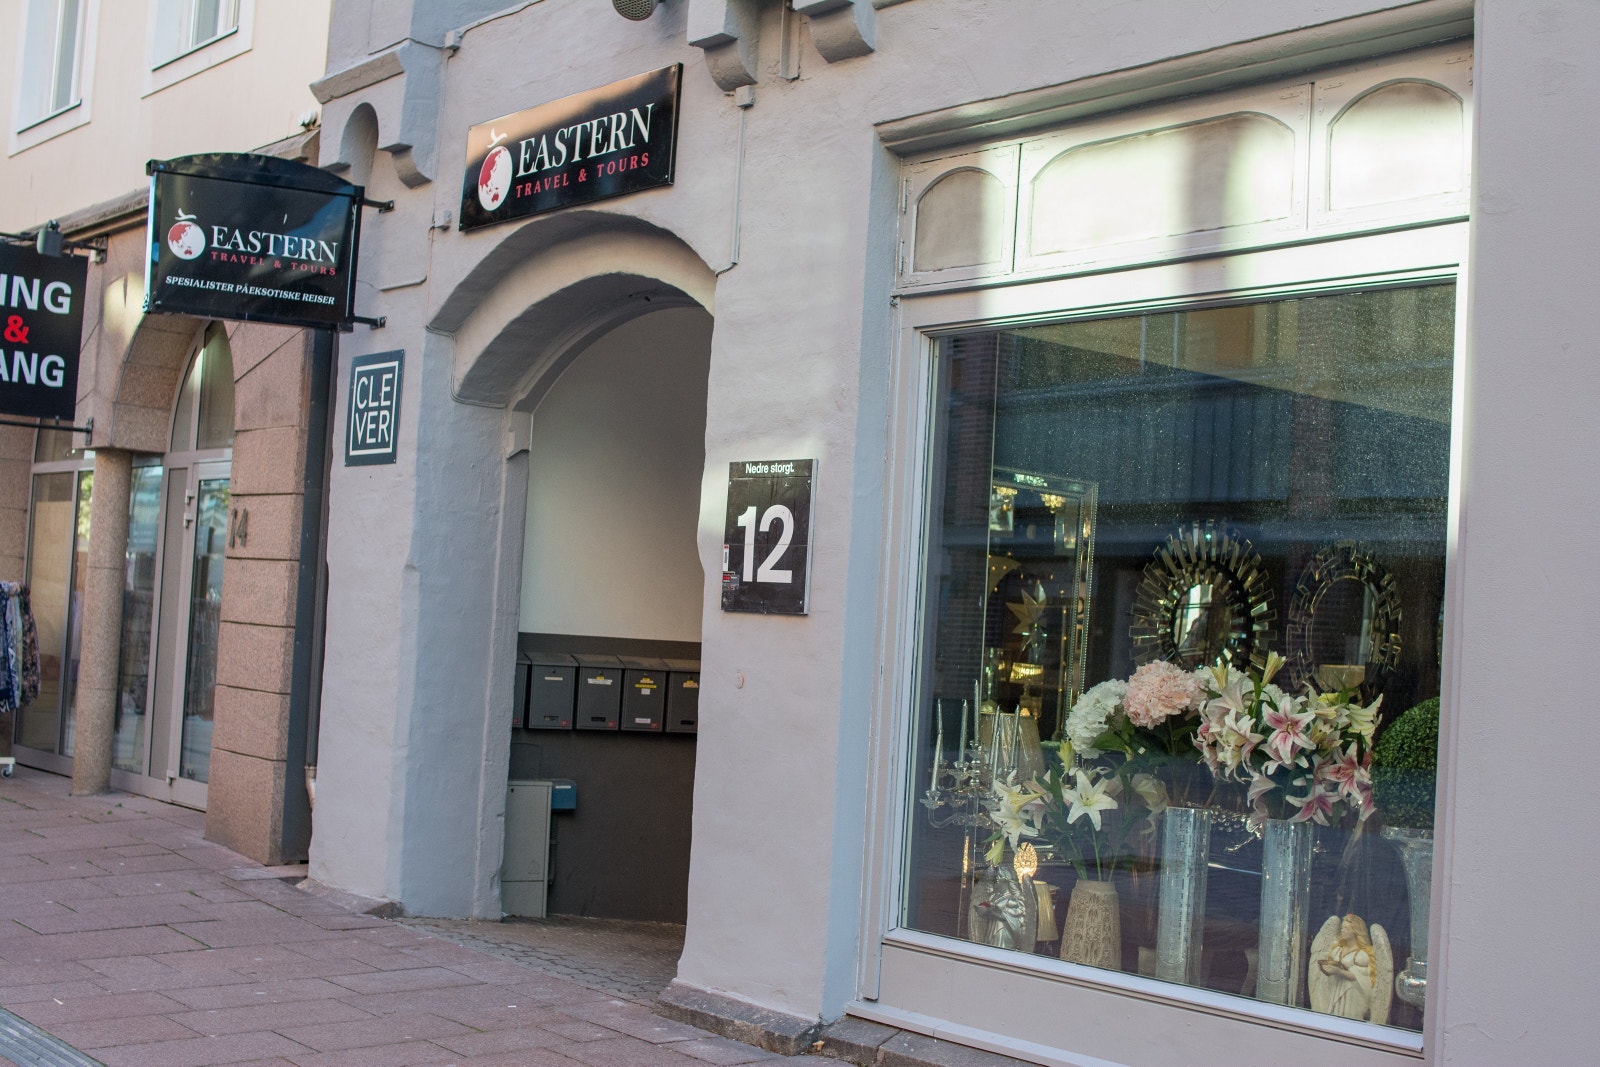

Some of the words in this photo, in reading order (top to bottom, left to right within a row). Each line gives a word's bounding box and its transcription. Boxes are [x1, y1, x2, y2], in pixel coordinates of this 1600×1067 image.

[515, 102, 655, 178] EASTERN
[515, 176, 569, 198] TRAVEL
[578, 168, 587, 182] &
[597, 152, 649, 178] TOURS
[210, 225, 338, 263] EASTERN
[211, 251, 264, 266] TRAVEL
[273, 260, 282, 269] &
[291, 261, 336, 276] TOURS
[165, 275, 234, 292] SPESIALISTER
[302, 293, 335, 305] REISER
[4, 315, 30, 344] &
[356, 373, 393, 410] CLE
[355, 409, 390, 445] VER
[745, 462, 769, 474] Nedre
[770, 462, 795, 475] storgt.
[229, 507, 249, 549] 14
[737, 504, 795, 584] 12
